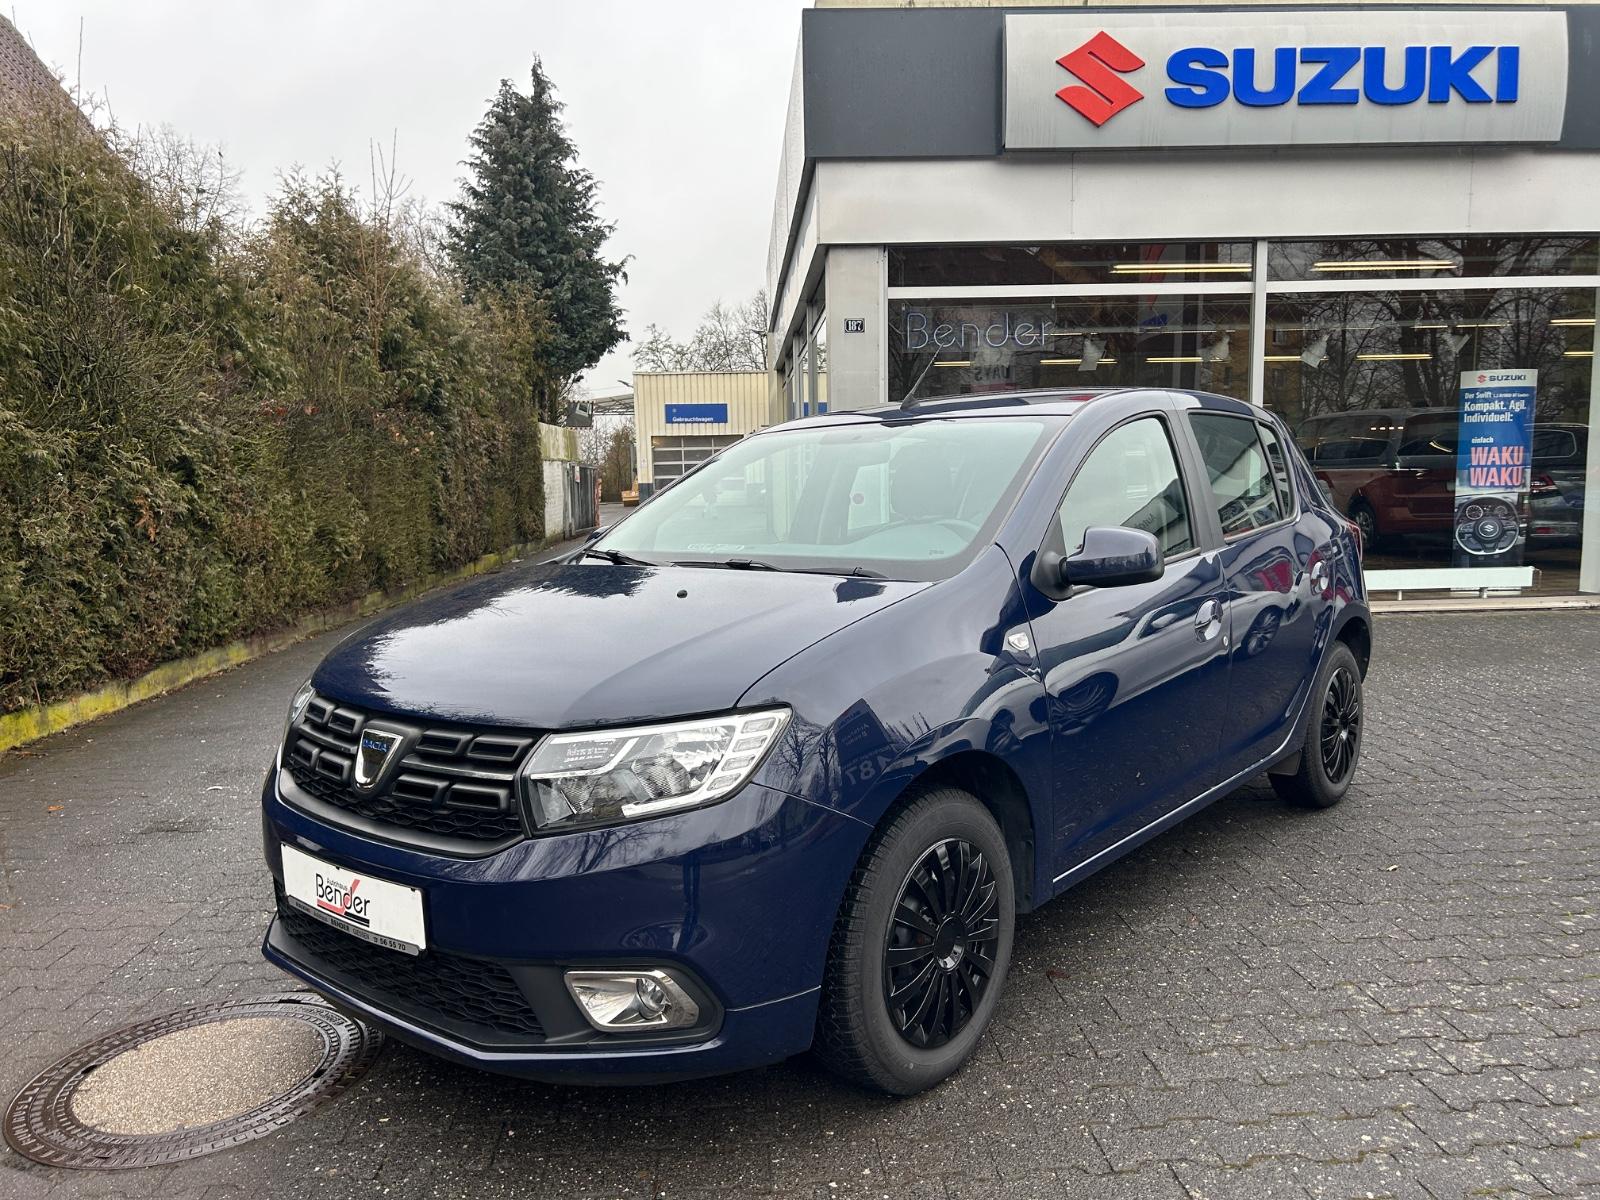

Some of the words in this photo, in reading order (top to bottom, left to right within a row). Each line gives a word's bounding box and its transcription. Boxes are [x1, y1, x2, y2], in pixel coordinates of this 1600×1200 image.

[1164, 45, 1520, 108] SUZUKI
[848, 320, 862, 331] 187
[906, 311, 1054, 350] Bender
[1475, 391, 1492, 399] Swift
[1464, 400, 1507, 412] Kompakt.
[1508, 399, 1527, 412] Agil.
[1463, 411, 1513, 422] Individuell:
[1470, 446, 1524, 465] WAKU
[1469, 467, 1523, 486] WAKU
[316, 873, 371, 916] Bender
